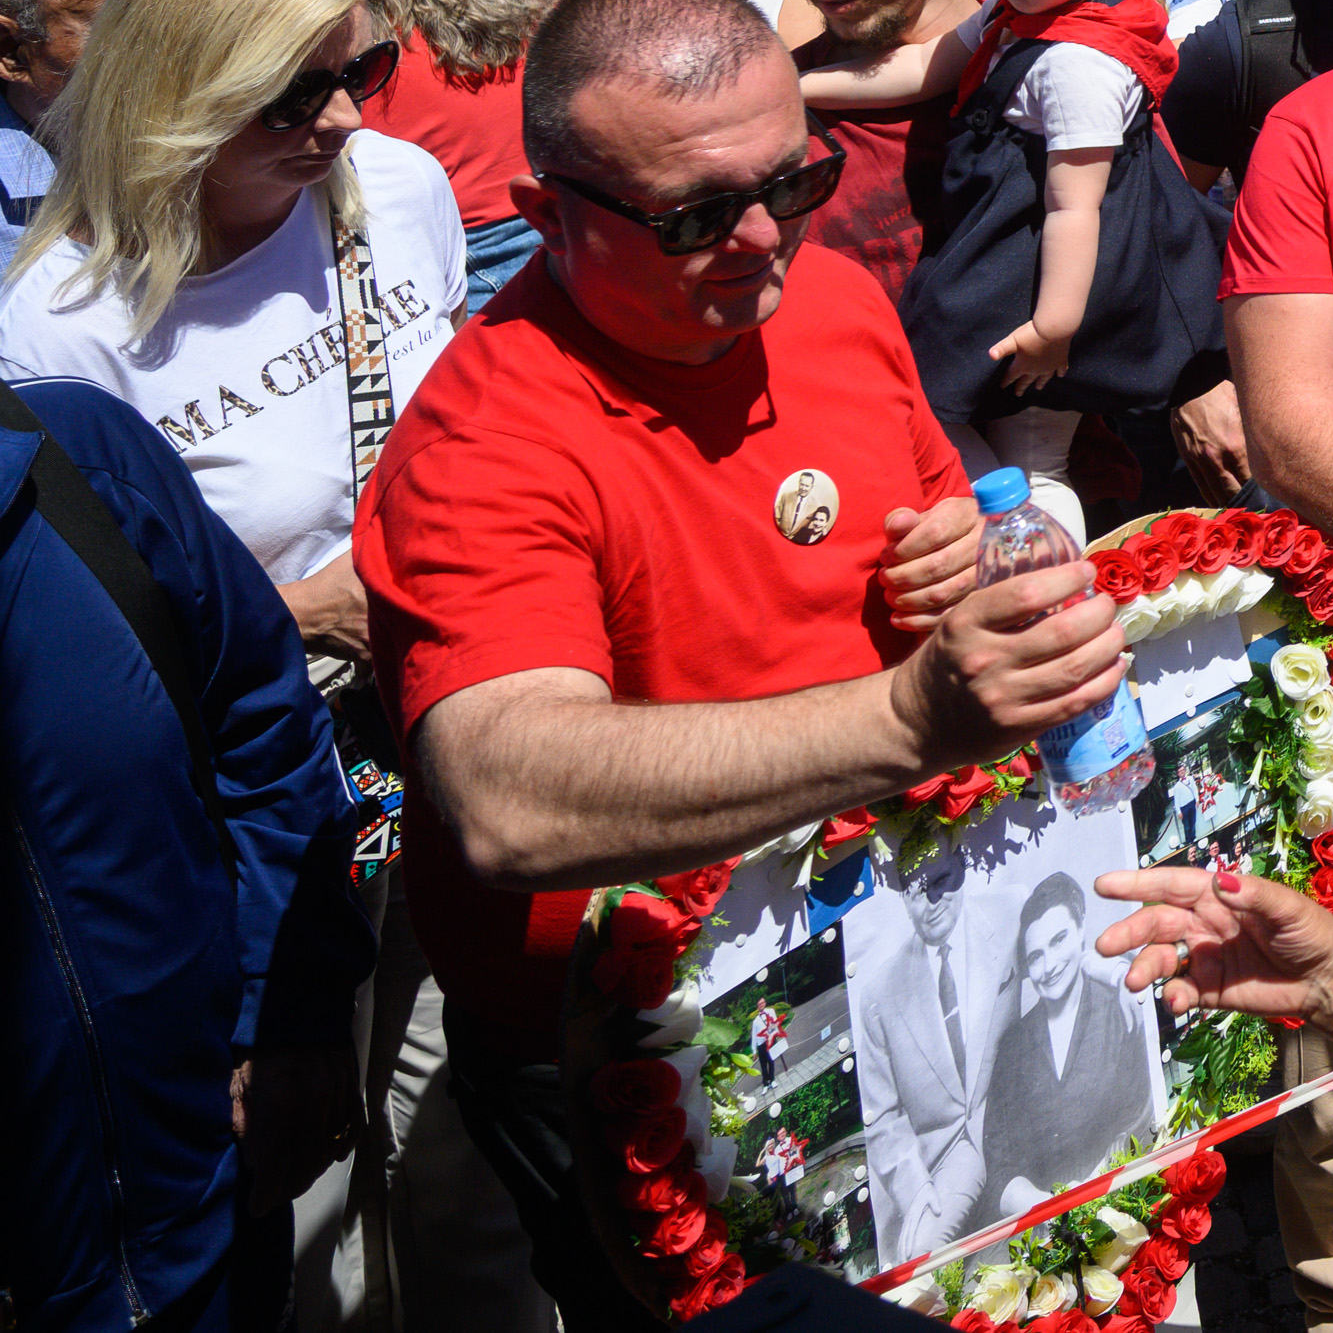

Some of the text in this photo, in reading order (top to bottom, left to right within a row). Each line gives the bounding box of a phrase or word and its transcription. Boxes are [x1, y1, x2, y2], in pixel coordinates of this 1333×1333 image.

[156, 279, 431, 454] MA CHÉIE
[417, 329, 432, 346] la
